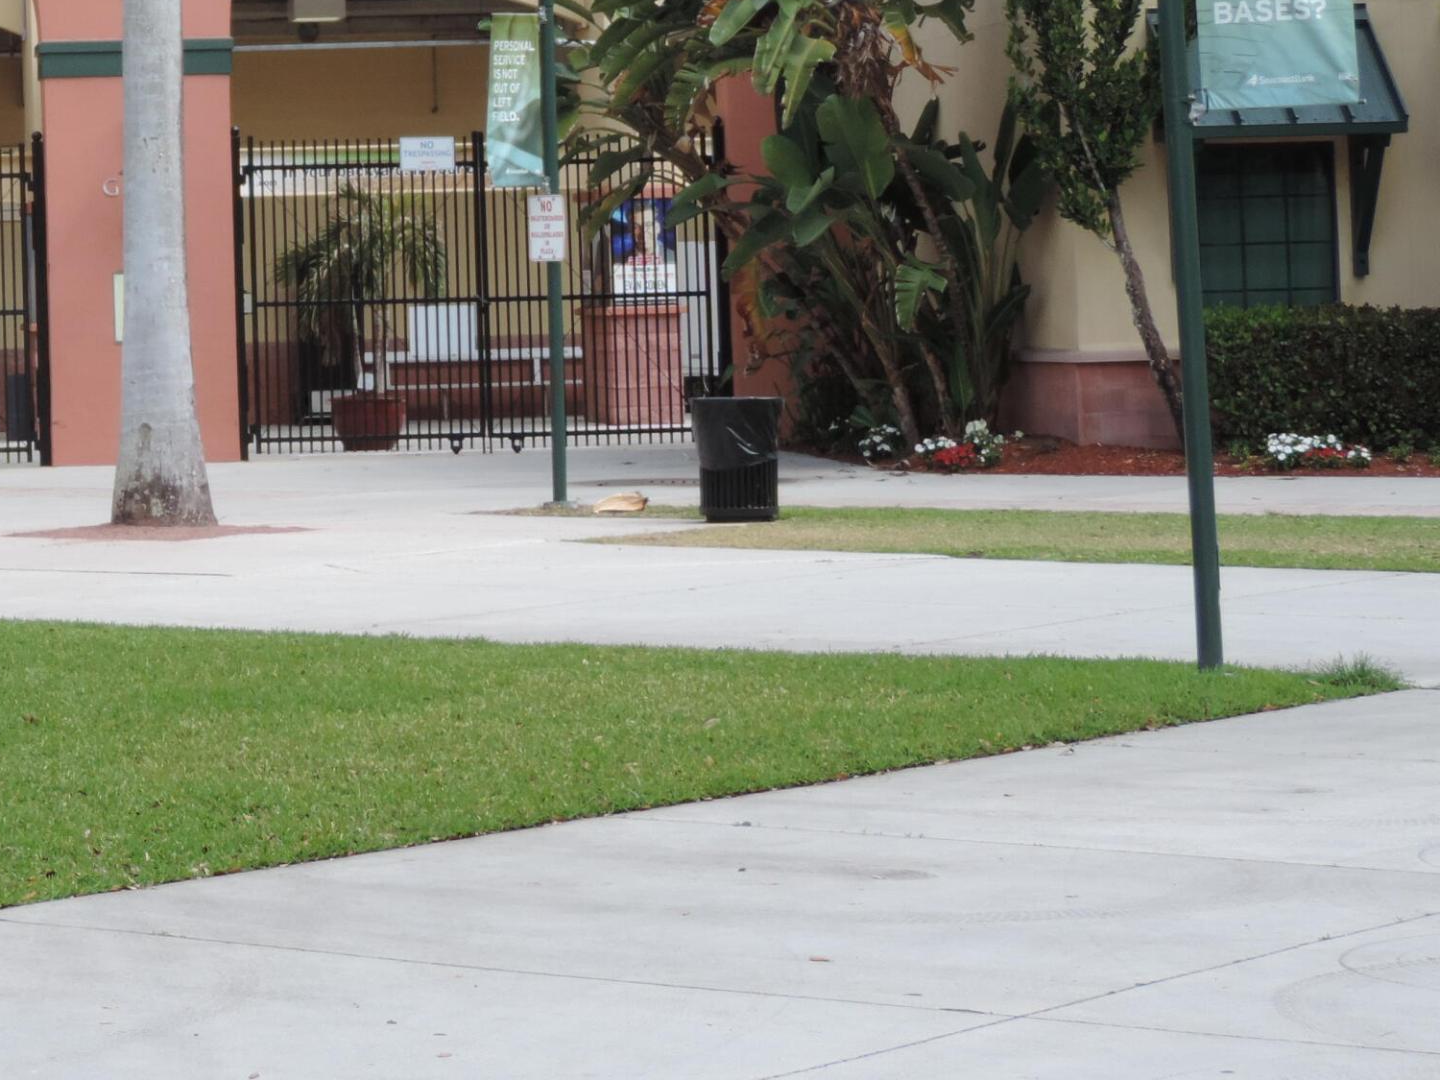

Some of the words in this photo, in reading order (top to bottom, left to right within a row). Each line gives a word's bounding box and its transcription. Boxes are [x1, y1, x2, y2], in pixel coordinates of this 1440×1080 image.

[493, 39, 535, 51] PERSONAL
[493, 53, 526, 65] SERVICE
[494, 82, 507, 93] OUT
[509, 82, 520, 93] OF
[492, 96, 512, 107] LEFT
[420, 140, 433, 149] NO
[540, 200, 552, 212] NO
